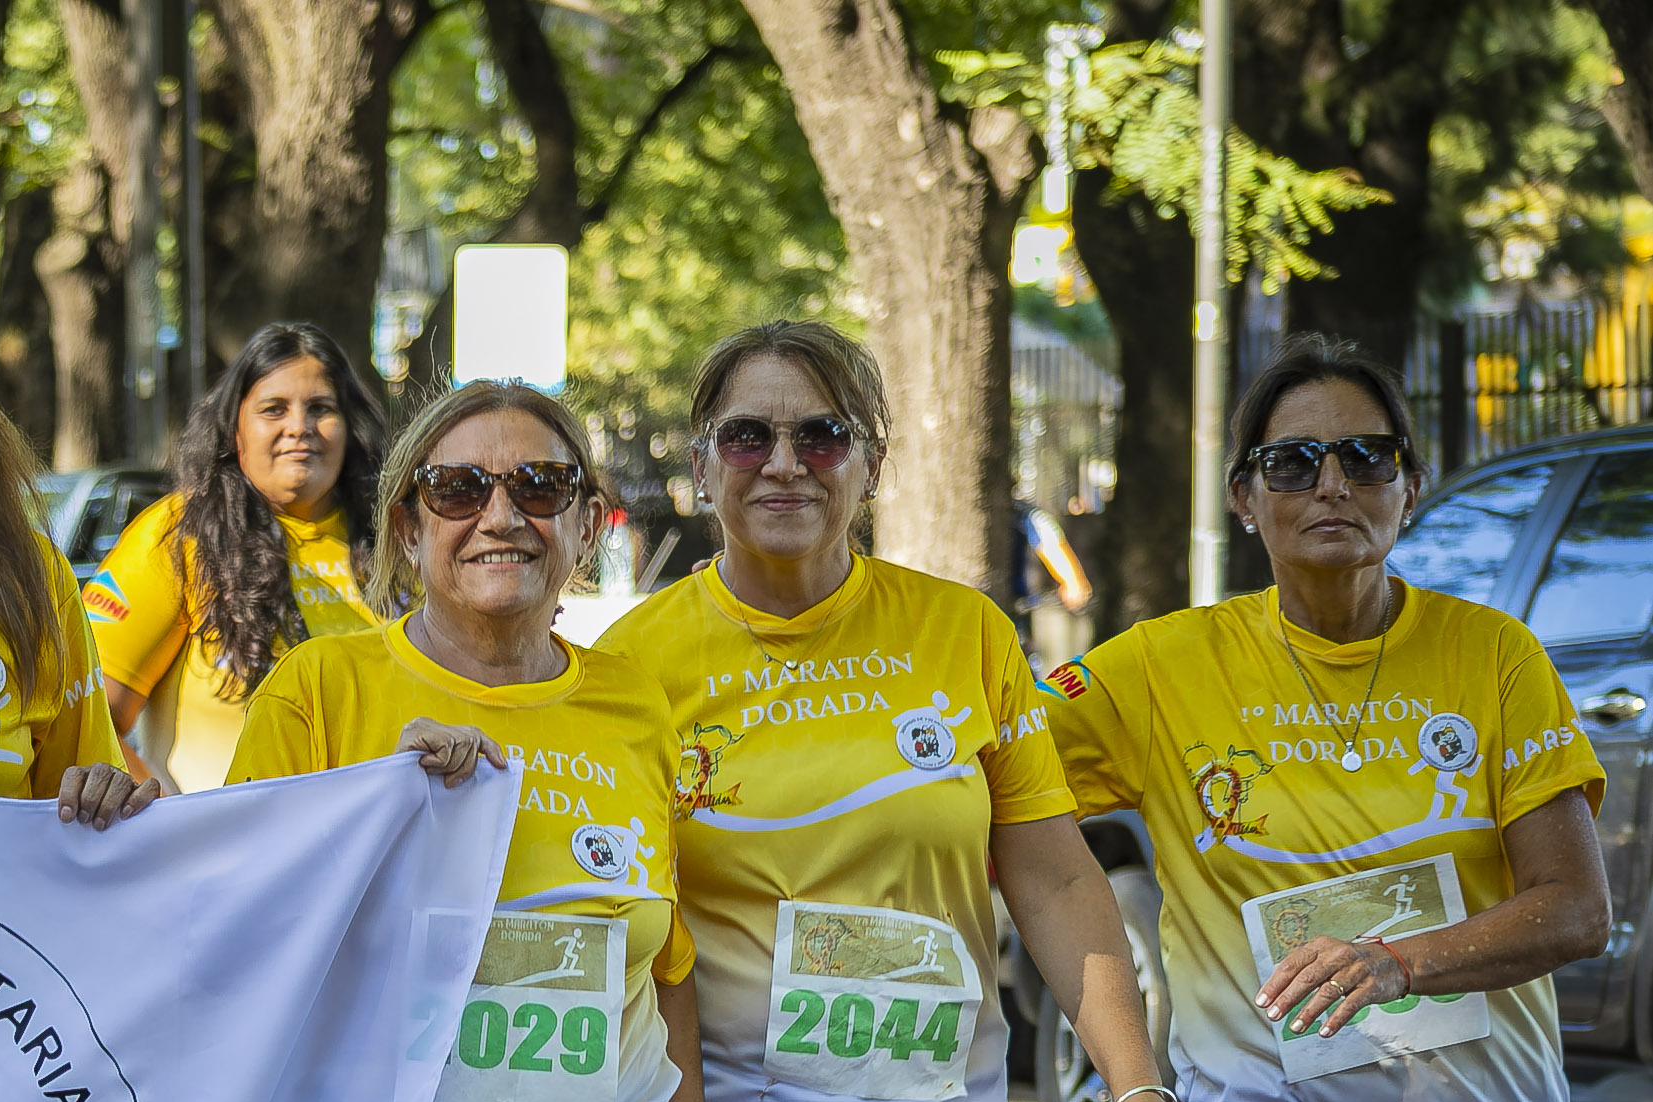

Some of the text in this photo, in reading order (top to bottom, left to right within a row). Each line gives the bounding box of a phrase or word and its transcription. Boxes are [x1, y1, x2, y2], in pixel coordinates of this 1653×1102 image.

[742, 648, 913, 693] MARATÓN
[741, 691, 891, 728] DORADA
[1273, 692, 1433, 727] MARATÓN
[1269, 736, 1409, 764] DORDA
[518, 786, 594, 820] ADA
[776, 989, 963, 1062] 2044
